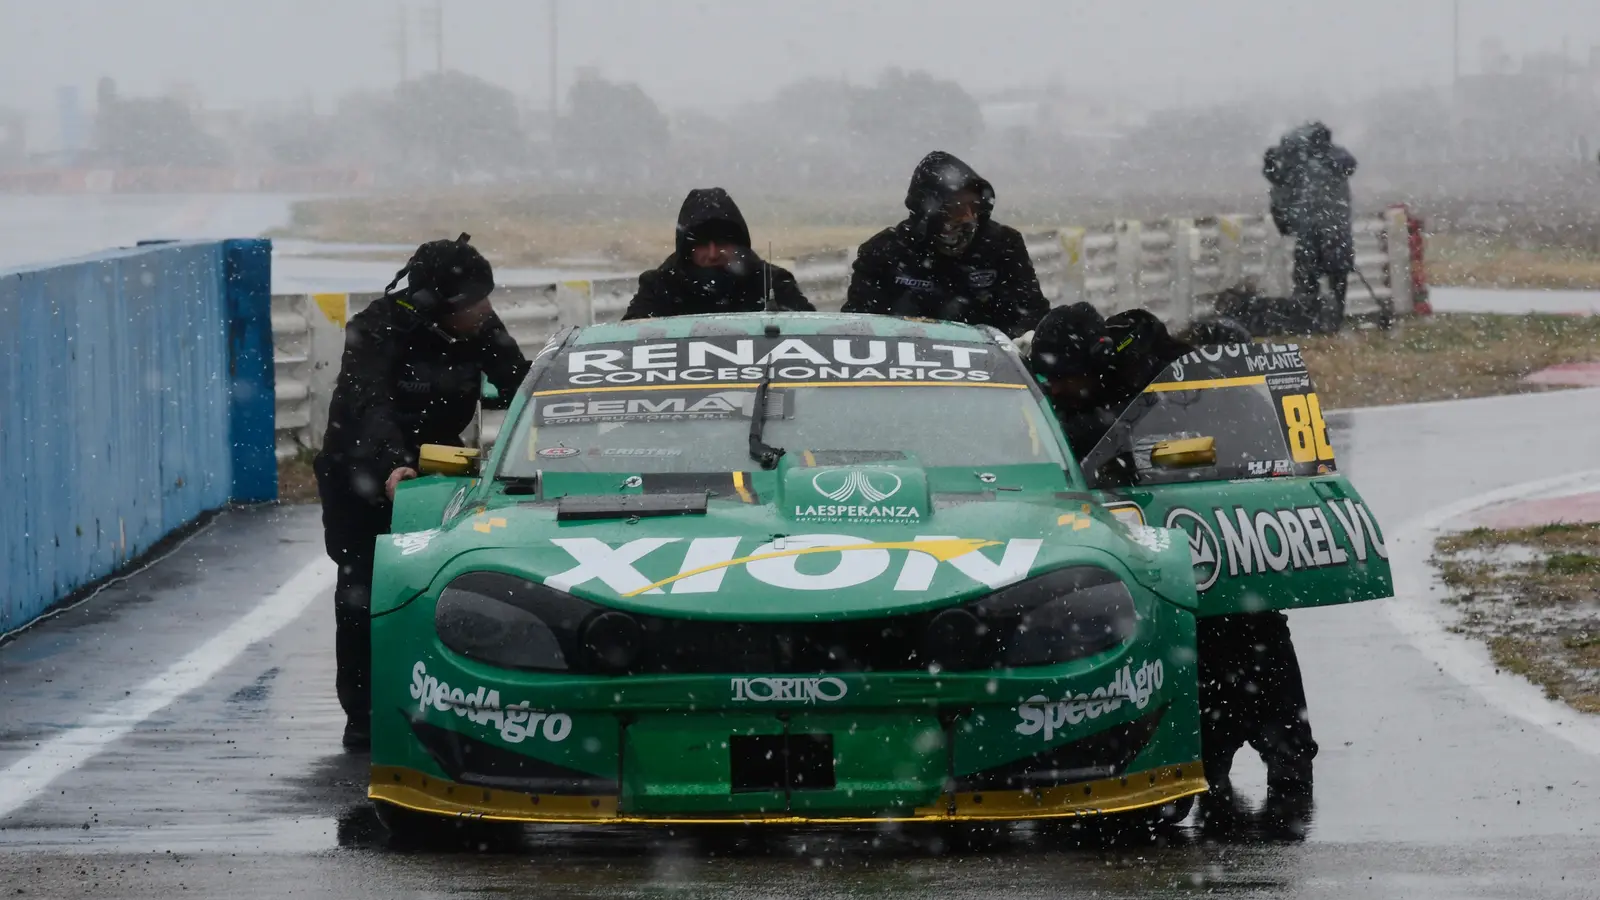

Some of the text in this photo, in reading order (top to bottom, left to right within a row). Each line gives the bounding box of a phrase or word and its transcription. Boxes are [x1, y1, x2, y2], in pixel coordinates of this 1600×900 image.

[568, 339, 988, 373] RENAULT
[569, 364, 991, 384] CONCESIONARIOS
[543, 397, 736, 417] CEMA
[544, 414, 684, 425] CONSTRUCTORA
[795, 505, 920, 517] LAESPERANZA
[1214, 507, 1347, 576] MOREL
[543, 534, 1044, 594] XION
[409, 660, 573, 743] SpeedAgro
[731, 677, 848, 704] TORINO
[1015, 658, 1164, 742] SpeedAgro
